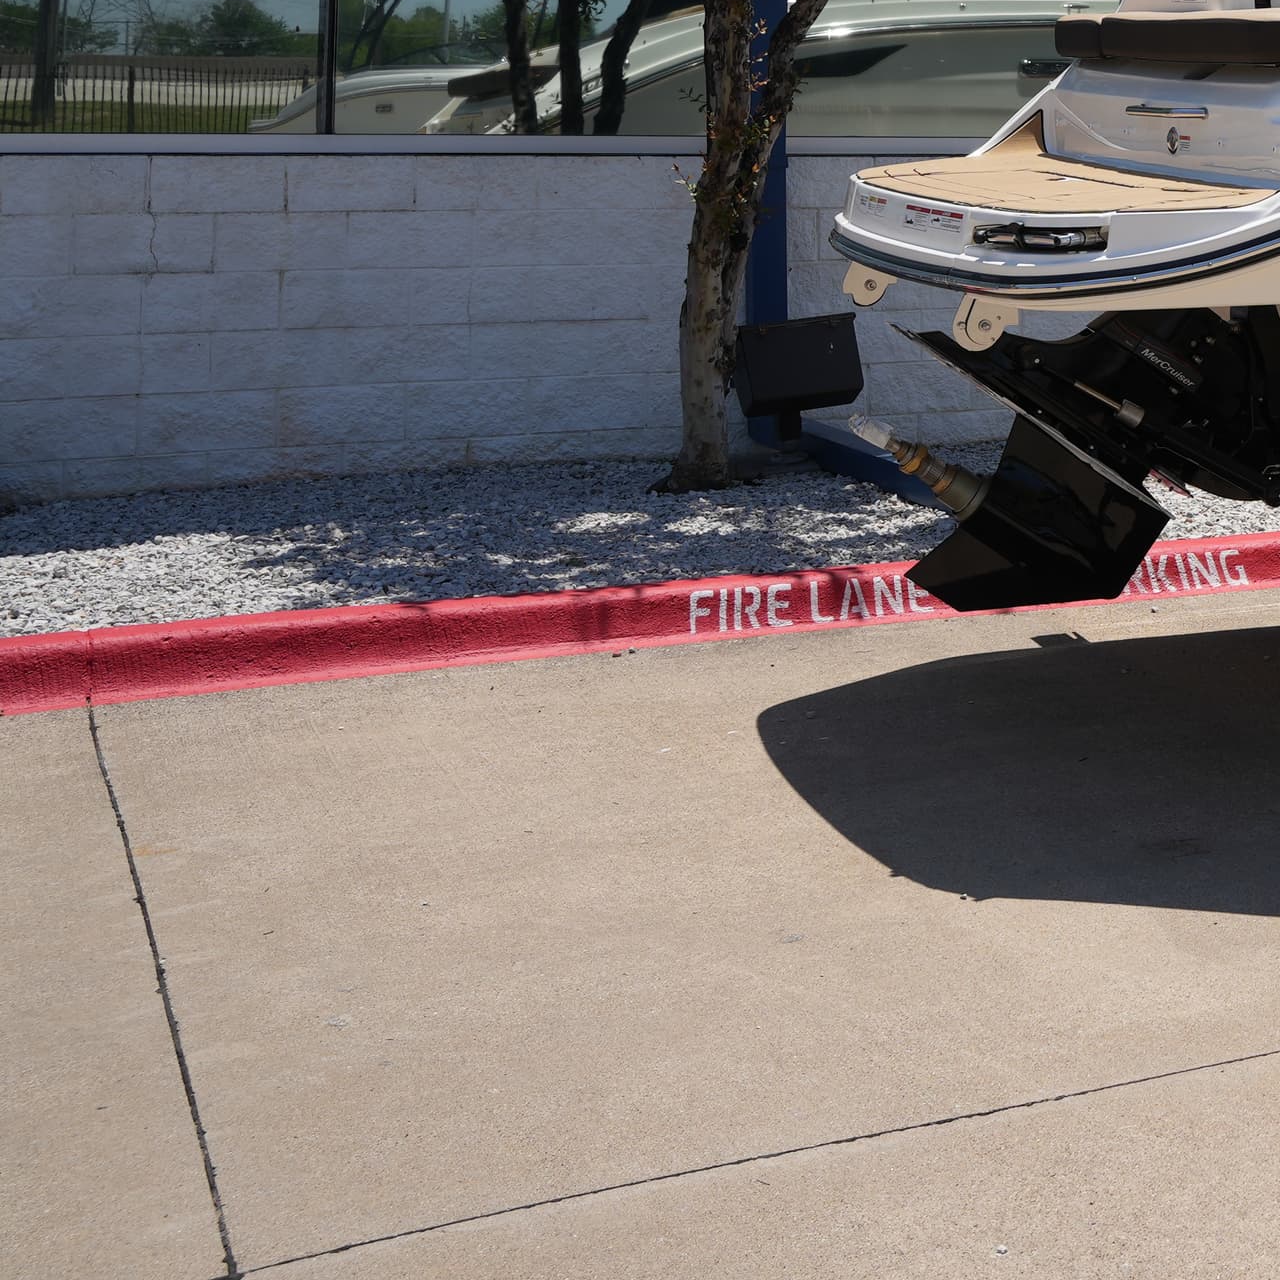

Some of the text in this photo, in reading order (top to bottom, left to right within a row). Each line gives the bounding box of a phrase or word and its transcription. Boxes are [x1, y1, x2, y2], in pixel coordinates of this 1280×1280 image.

[1141, 348, 1195, 387] MerCruiser
[689, 583, 793, 634] FIRE
[810, 575, 935, 624] LANE
